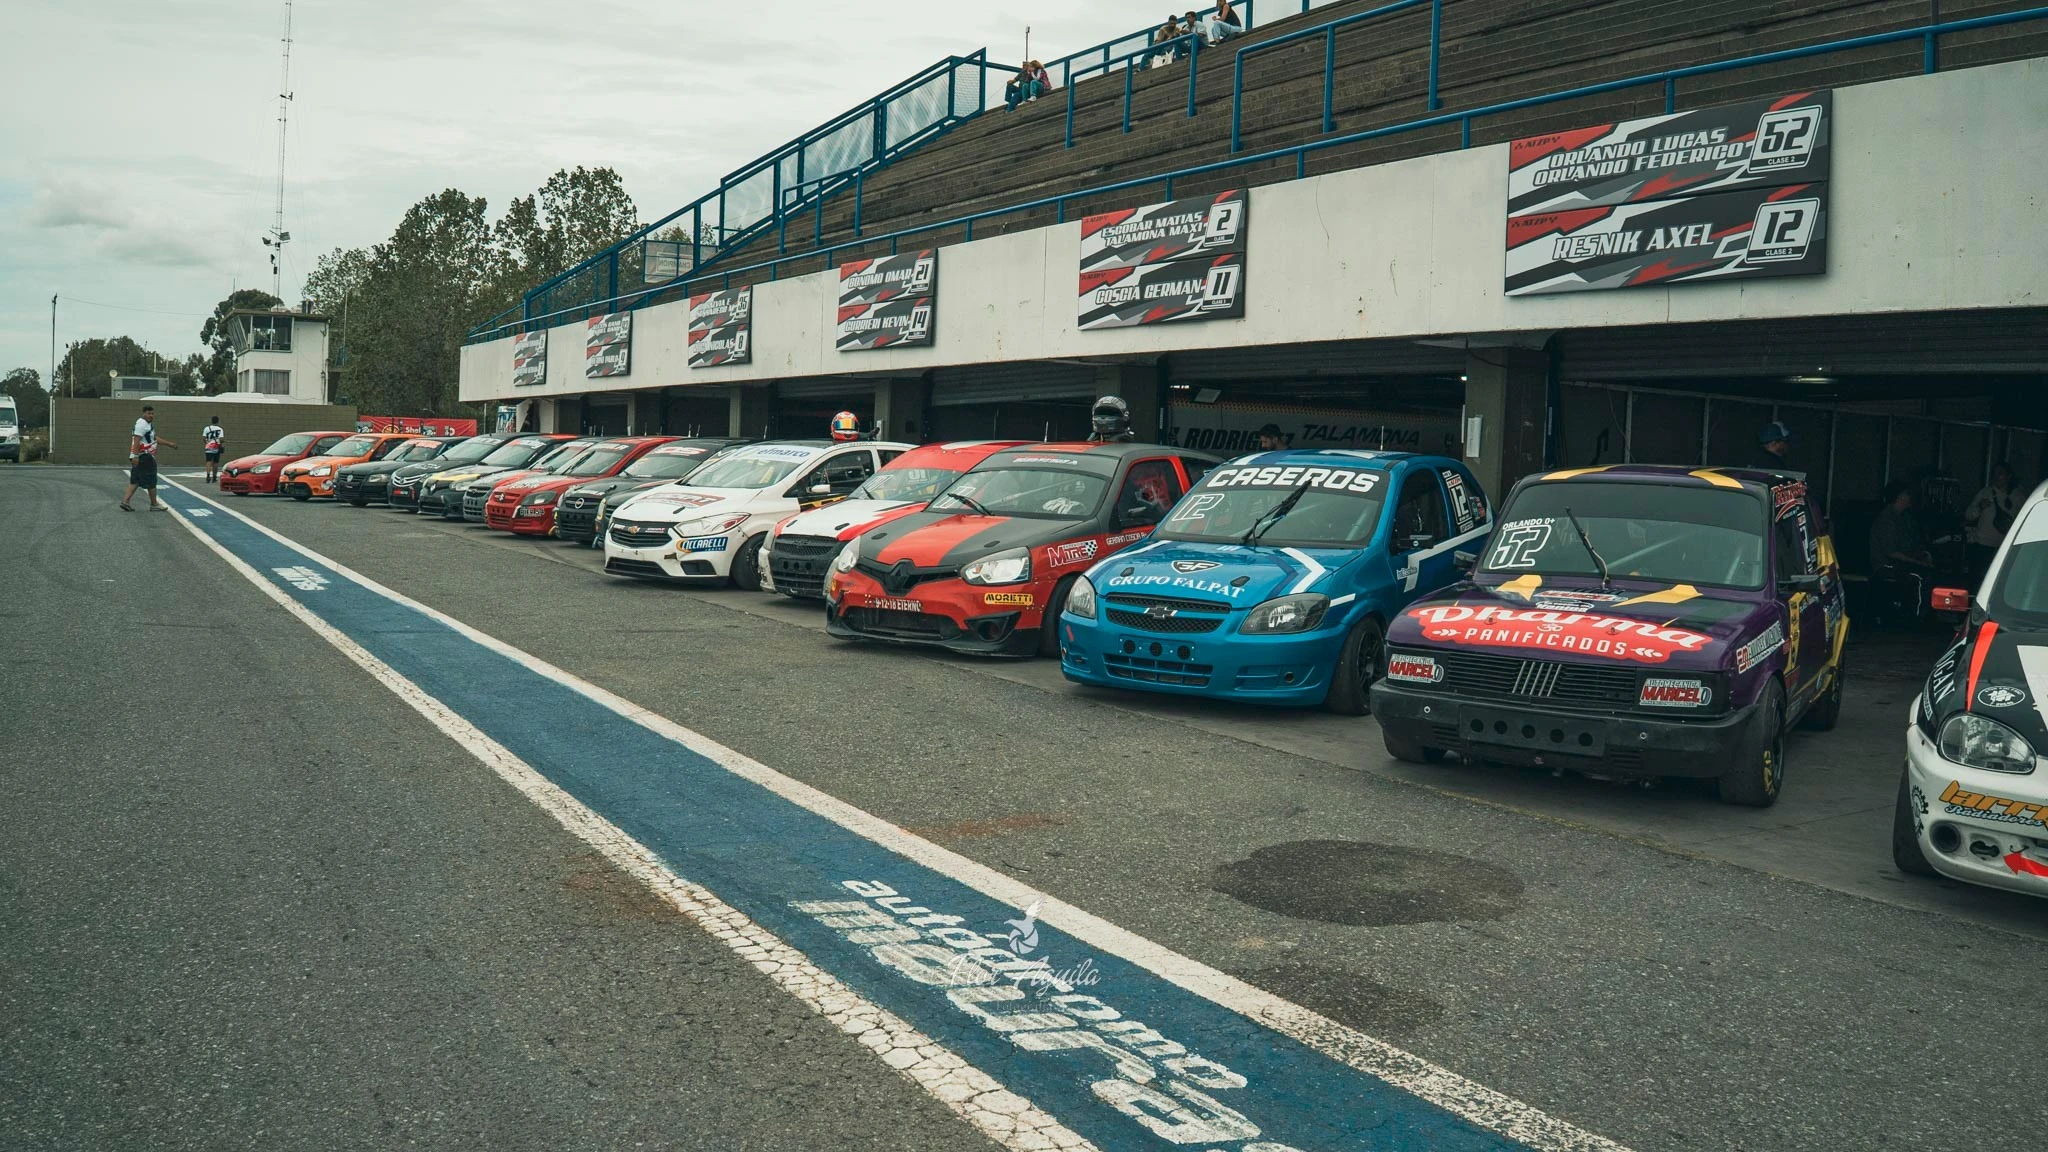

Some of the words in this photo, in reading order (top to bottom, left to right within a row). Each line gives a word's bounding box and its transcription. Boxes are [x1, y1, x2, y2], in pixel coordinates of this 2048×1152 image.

[1549, 143, 1645, 169] ORLANDO
[1651, 127, 1728, 152] LUCAS
[1760, 116, 1812, 154] 52
[1533, 162, 1628, 187] ORLANDO
[1634, 144, 1744, 172] FEDERICO
[1767, 158, 1787, 166] CLASE
[1101, 220, 1154, 238] ESCOBAR
[1155, 211, 1203, 227] MATIAS
[1216, 208, 1232, 231] 2
[1762, 209, 1804, 246] 12
[1105, 228, 1165, 247] TALAMONA
[1169, 222, 1203, 236] MAXI
[1552, 230, 1642, 261] RESNIK
[1646, 223, 1714, 250] AXEL
[885, 268, 912, 282] OMAR
[915, 263, 930, 281] 21
[1211, 271, 1231, 296] 11
[1095, 285, 1140, 305] COSCIA
[1144, 278, 1202, 299] GERMAN
[912, 310, 927, 329] 14
[1183, 427, 1296, 451] RODRIGZ
[1302, 424, 1421, 448] TALAMONA
[1206, 466, 1380, 493] CASEROS
[1171, 493, 1225, 522] 12
[1451, 484, 1470, 518] 12
[1502, 518, 1543, 530] ORLANDO
[1488, 524, 1552, 570] 52
[1109, 575, 1171, 587] GRUPO
[1171, 577, 1246, 598] FALPAT
[1418, 605, 1705, 648] Dharma
[1464, 627, 1628, 656] PANIFICADOS
[1944, 804, 2044, 827] Radiadores
[787, 900, 1305, 1152] moura
